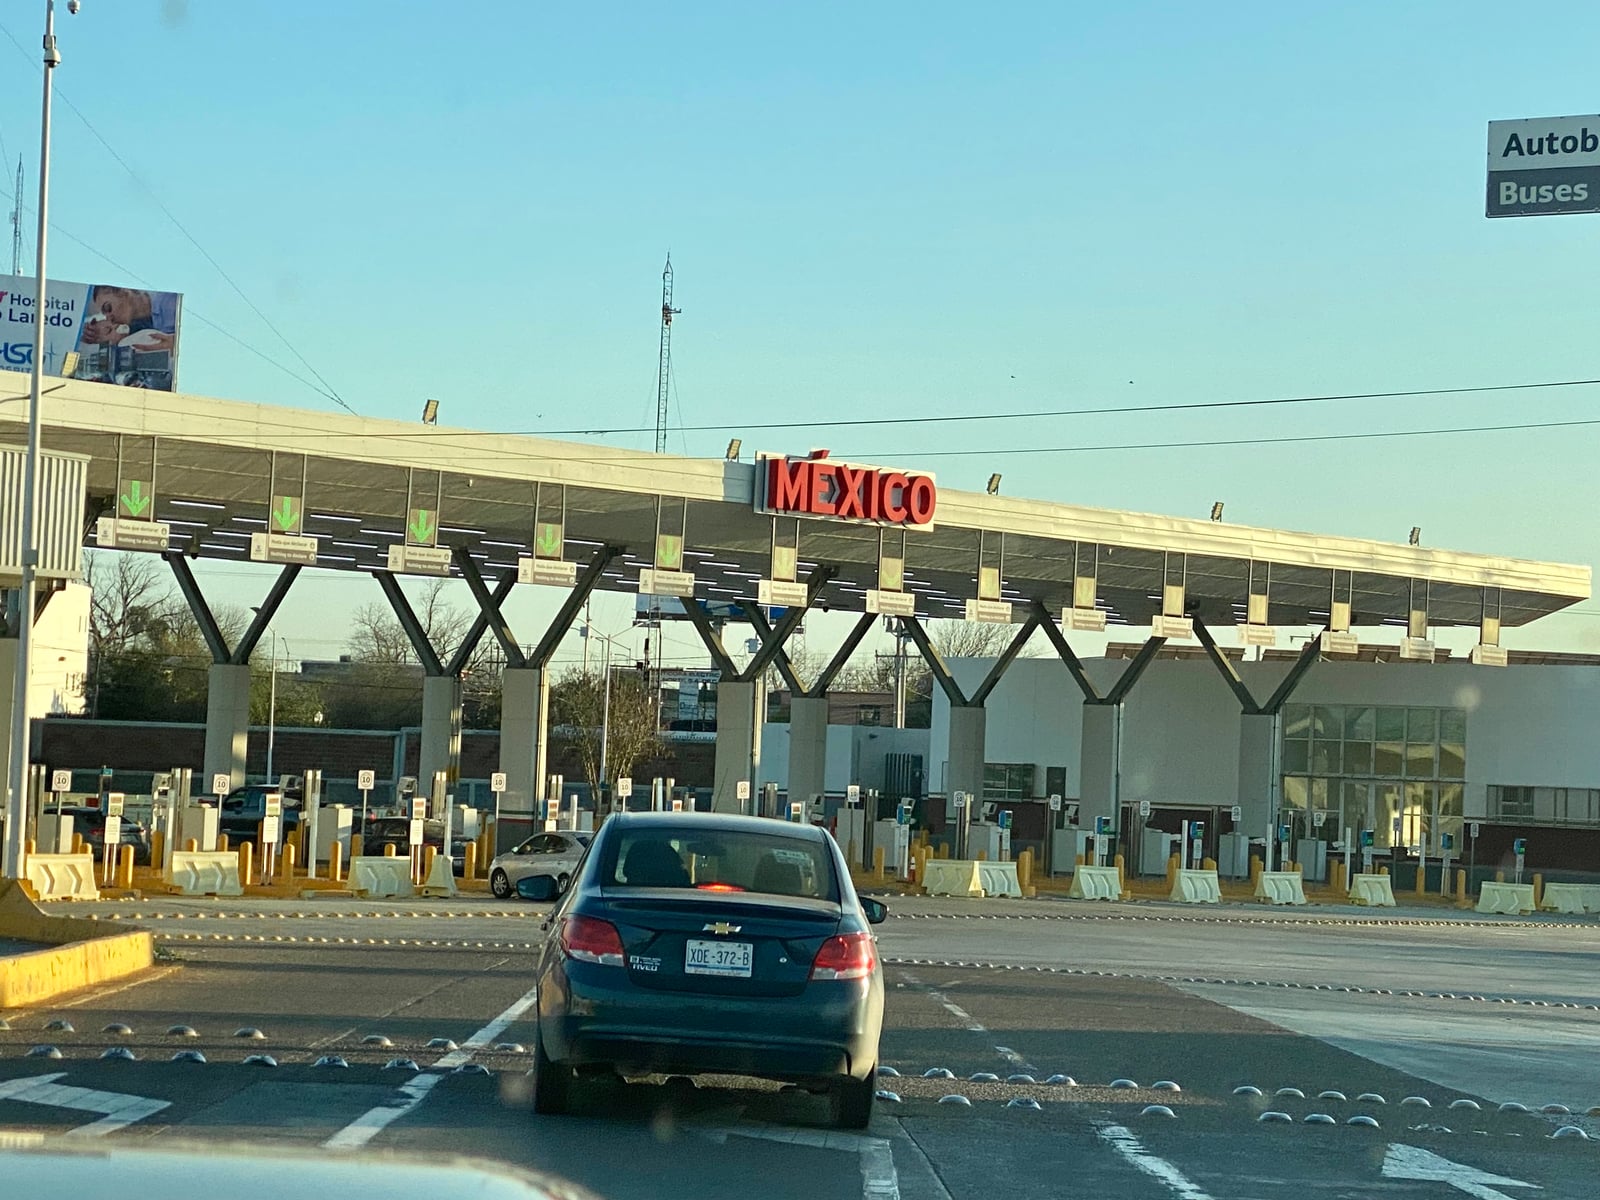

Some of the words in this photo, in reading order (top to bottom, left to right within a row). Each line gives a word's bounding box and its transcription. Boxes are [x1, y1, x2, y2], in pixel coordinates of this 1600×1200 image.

[1502, 128, 1599, 157] Autob
[1500, 182, 1588, 205] Buses
[768, 450, 936, 524] MÉXICO
[57, 777, 67, 785] 10
[494, 778, 503, 786] 10
[740, 786, 747, 794] 10
